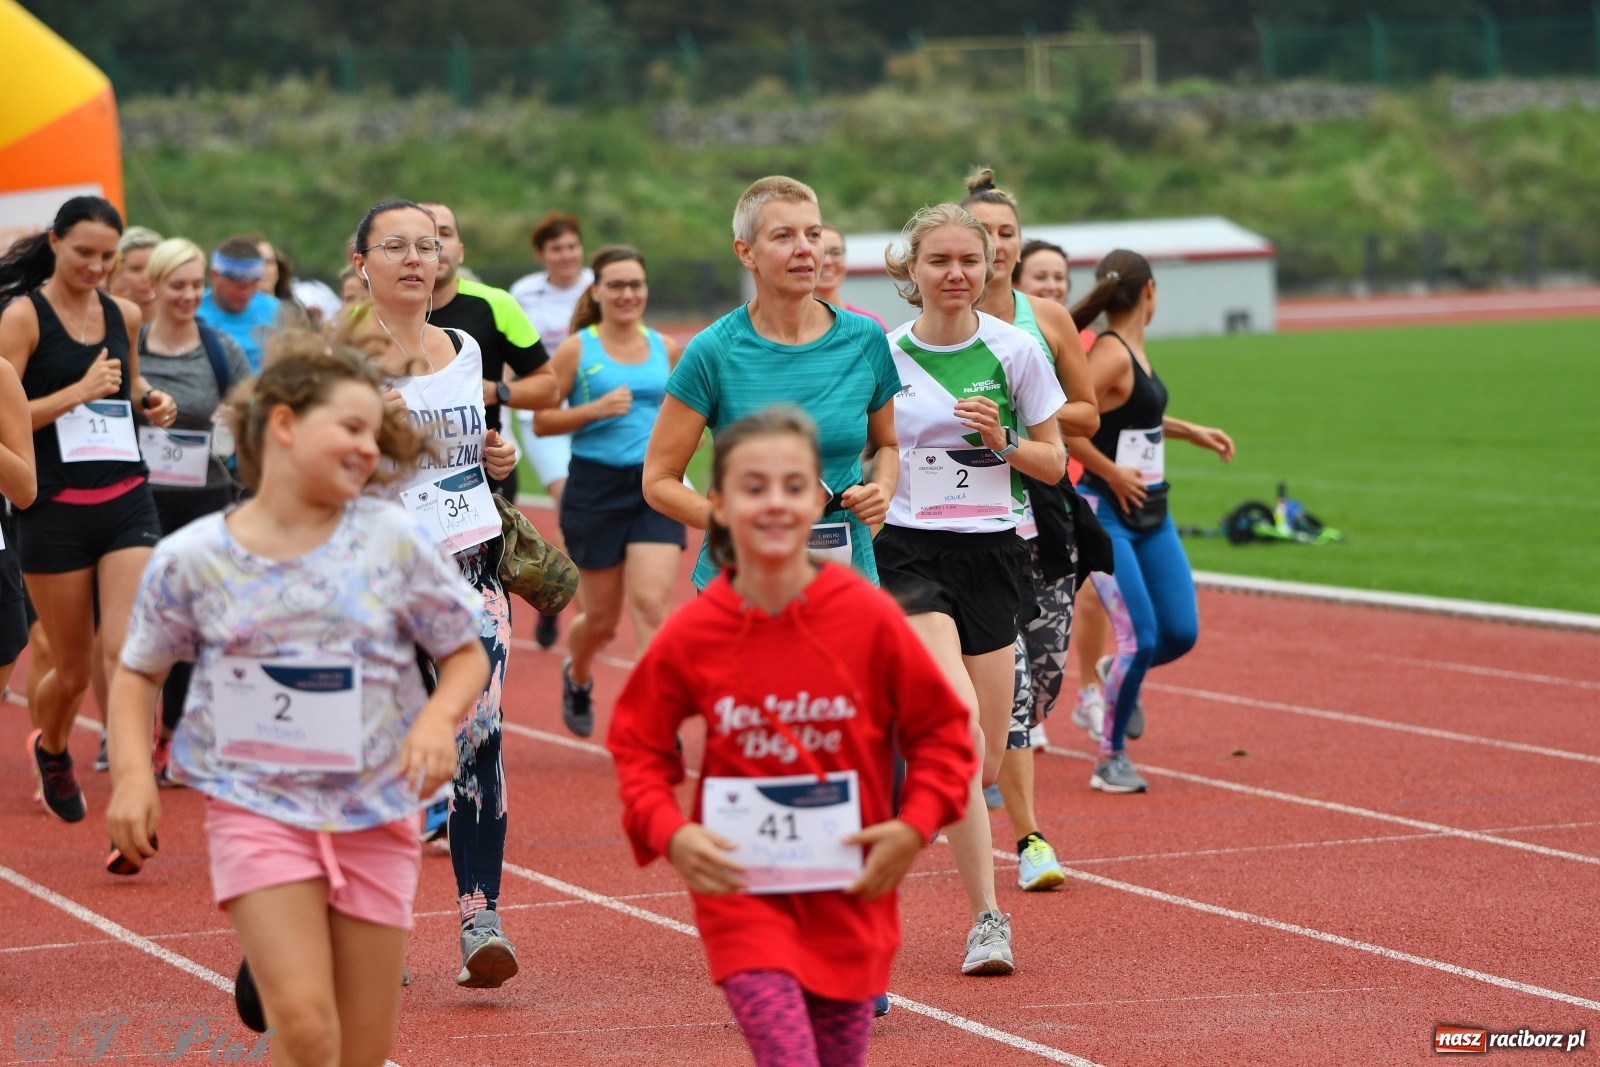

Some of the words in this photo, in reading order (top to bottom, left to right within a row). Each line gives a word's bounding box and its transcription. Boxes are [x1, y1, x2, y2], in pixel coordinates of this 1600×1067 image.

[88, 418, 109, 434] 11
[400, 404, 482, 442] OBIETA
[162, 445, 183, 462] 30
[956, 469, 969, 488] 2
[444, 494, 470, 517] 34
[274, 693, 292, 722] 2
[758, 812, 800, 842] 41
